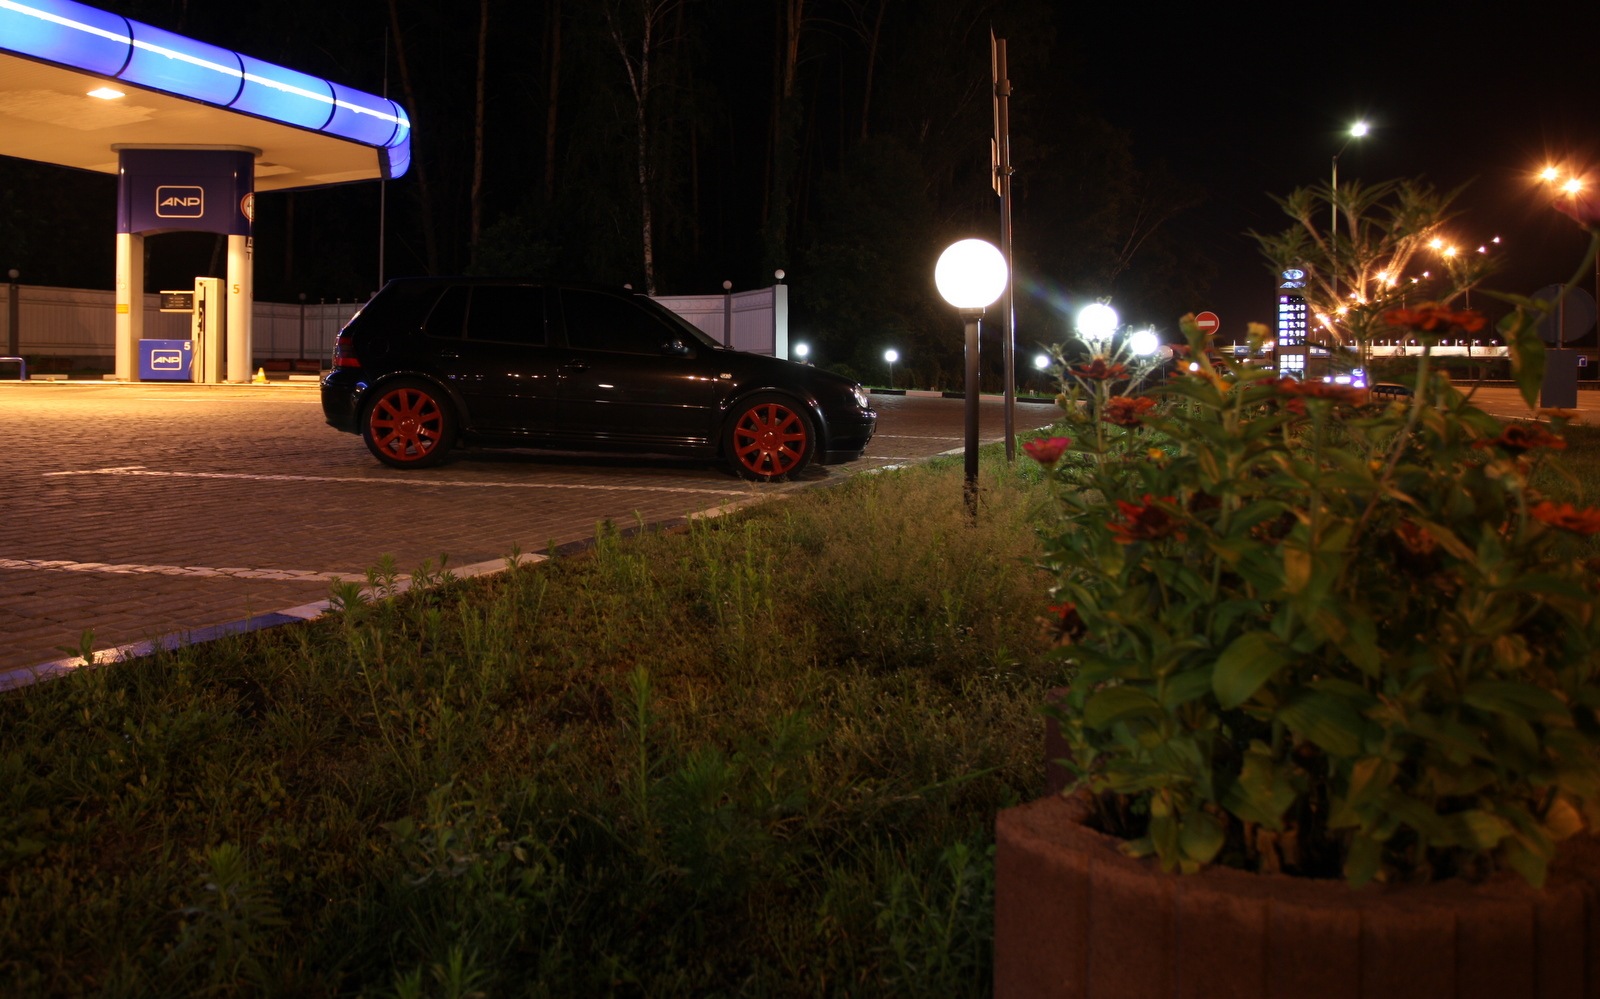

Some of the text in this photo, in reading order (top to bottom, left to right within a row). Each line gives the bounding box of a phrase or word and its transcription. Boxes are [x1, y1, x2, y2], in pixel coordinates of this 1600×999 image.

[159, 197, 201, 207] ANP
[233, 284, 240, 294] 5
[184, 341, 191, 351] 5
[153, 356, 180, 364] ANP
